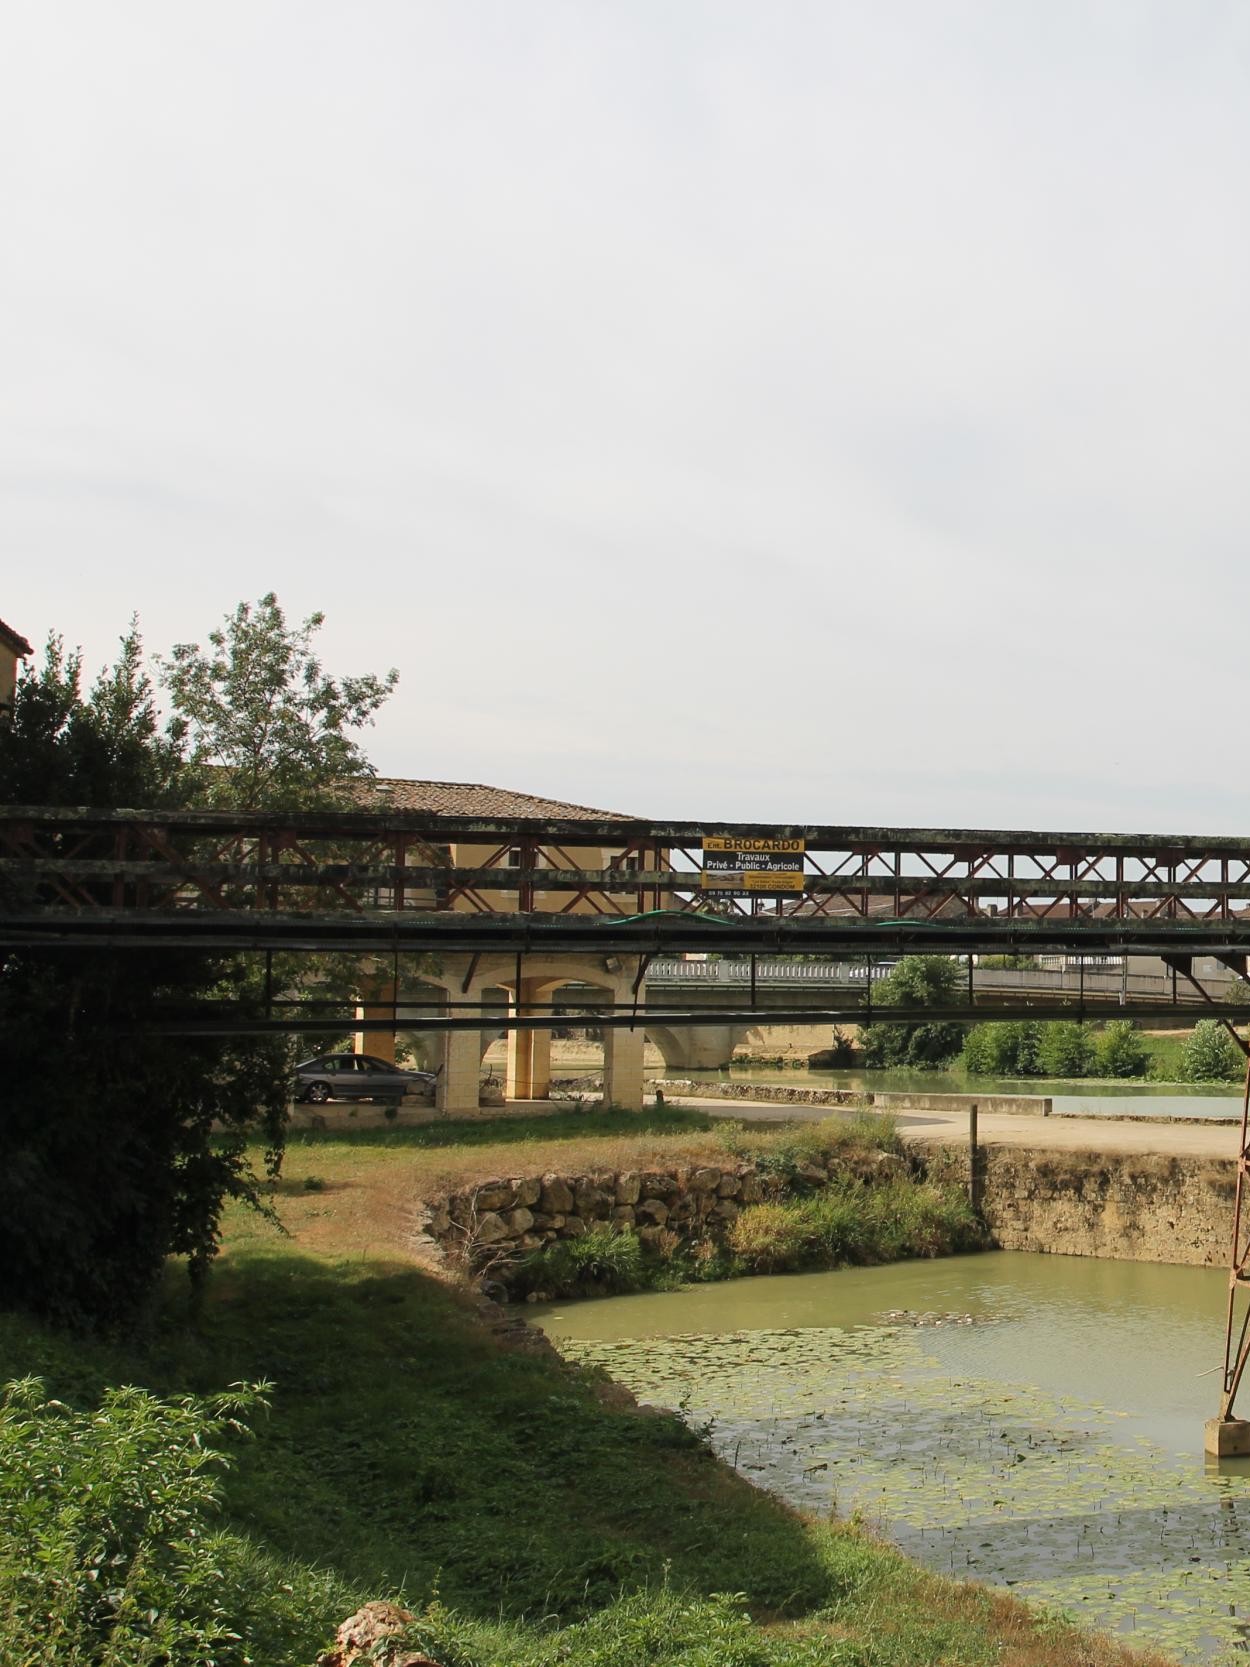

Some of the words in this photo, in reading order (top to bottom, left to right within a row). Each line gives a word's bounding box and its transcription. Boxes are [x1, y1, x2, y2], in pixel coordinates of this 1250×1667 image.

[724, 839, 800, 851] BROCARDO
[736, 852, 770, 861] Travaux
[706, 861, 728, 869] Privé
[735, 861, 760, 870] Public
[766, 862, 800, 871] Agricole
